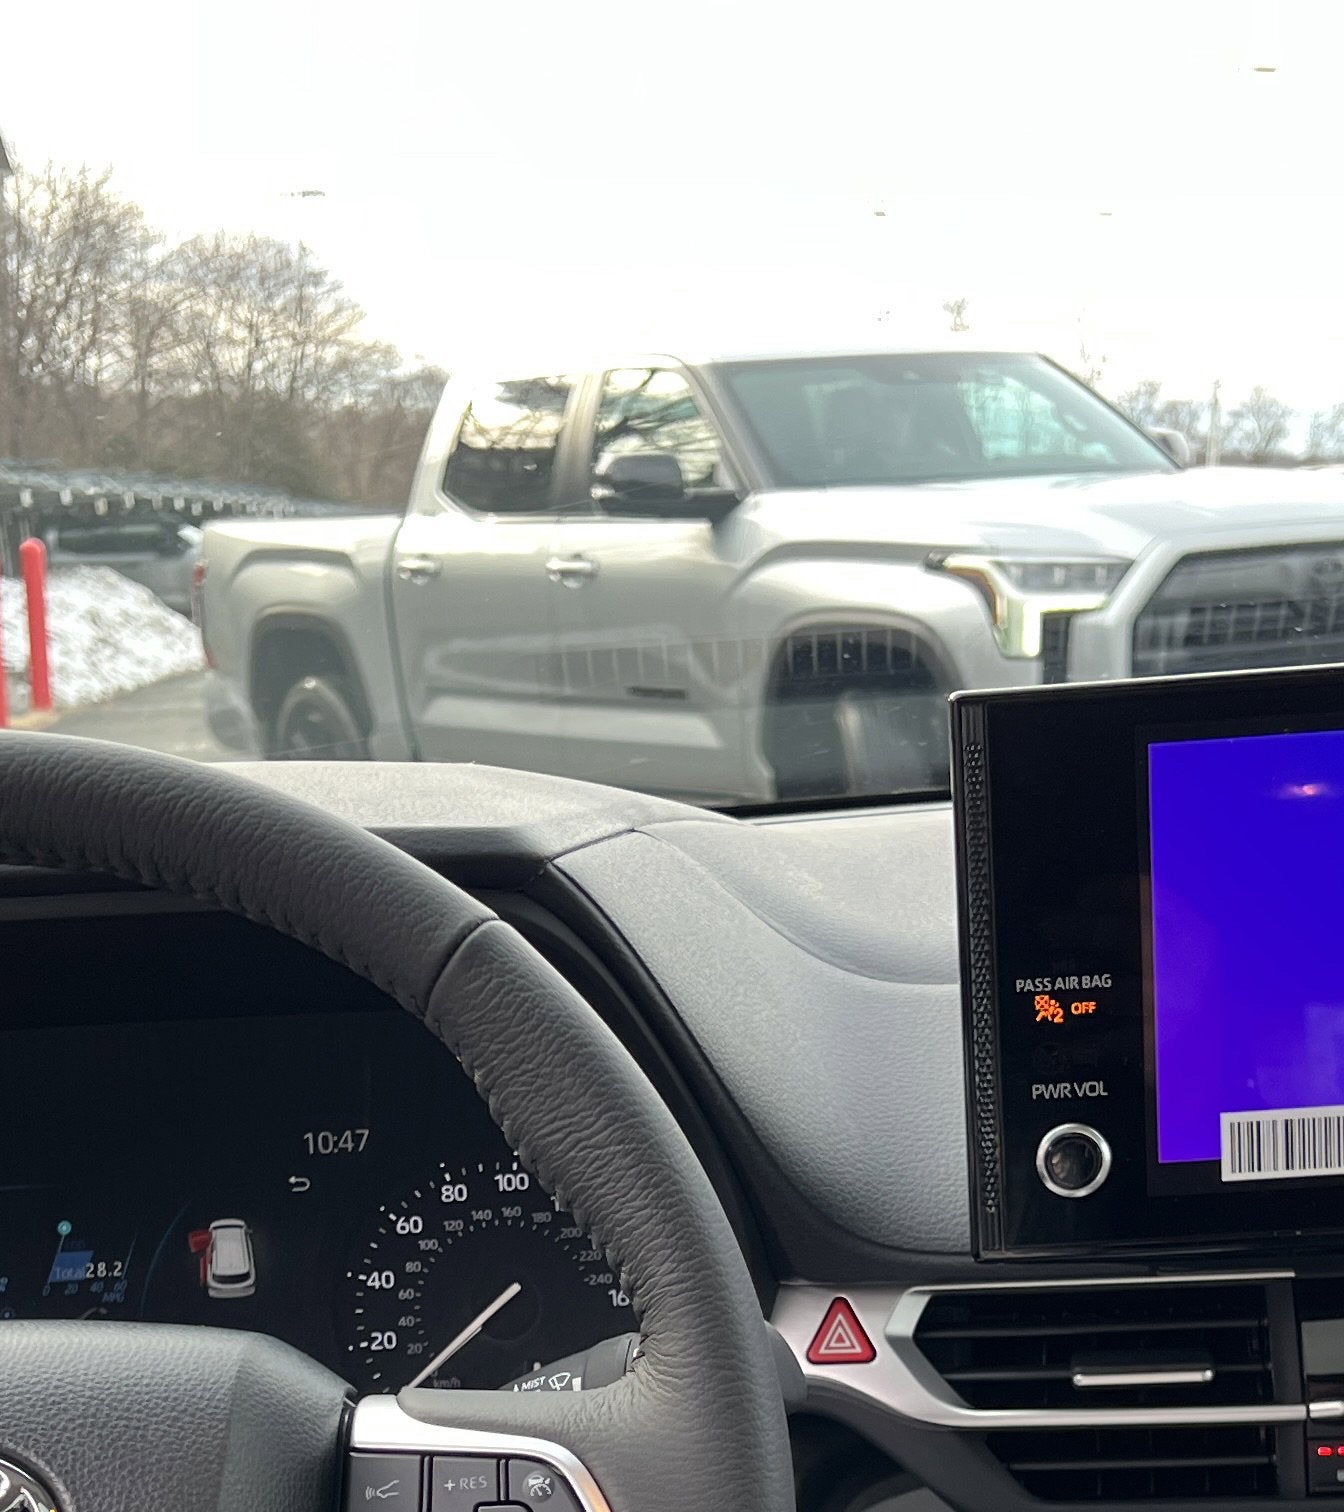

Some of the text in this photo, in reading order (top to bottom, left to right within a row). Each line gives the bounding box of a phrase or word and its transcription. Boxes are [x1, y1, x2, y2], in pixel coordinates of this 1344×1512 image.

[1016, 974, 1112, 992] PASS AIR BAG
[1070, 1001, 1097, 1015] OFF
[1031, 1080, 1109, 1100] PWR VOL
[304, 1128, 370, 1155] 10:47
[495, 1173, 529, 1192] 100
[441, 1184, 468, 1203] 80
[471, 1209, 492, 1221] 140
[501, 1206, 522, 1217] 160
[531, 1212, 552, 1223] 180
[396, 1216, 423, 1235] 60
[443, 1220, 464, 1232] 120
[560, 1227, 582, 1239] 200
[418, 1239, 439, 1250] 100
[579, 1250, 602, 1261] 220
[85, 1261, 122, 1279] 28.2
[405, 1261, 422, 1274] 80
[366, 1271, 395, 1290] 40
[588, 1273, 613, 1286] 240
[398, 1289, 414, 1301] 60
[608, 1289, 630, 1307] 16
[398, 1316, 414, 1327] 40
[371, 1332, 397, 1350] 20
[407, 1343, 423, 1355] 20
[432, 1377, 461, 1389] km/h
[521, 1376, 546, 1391] MIST
[459, 1476, 488, 1490] RES
